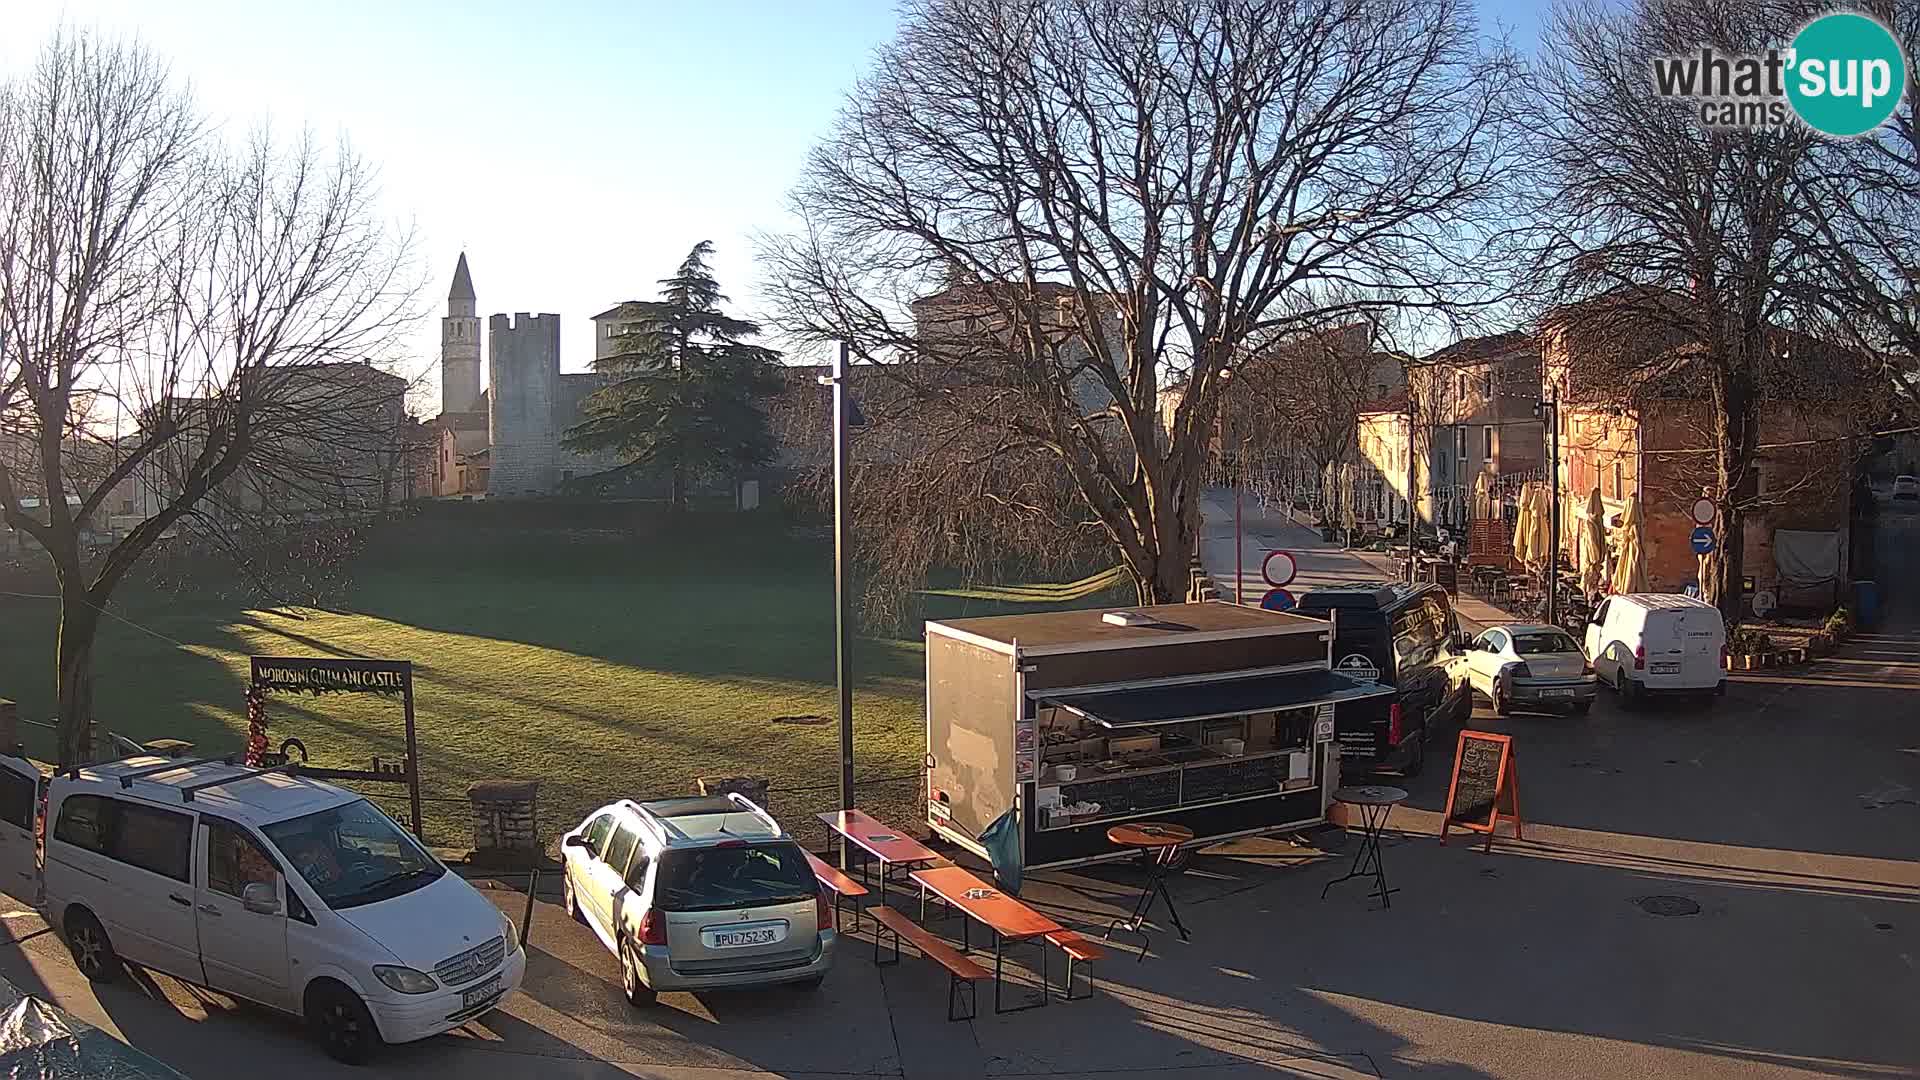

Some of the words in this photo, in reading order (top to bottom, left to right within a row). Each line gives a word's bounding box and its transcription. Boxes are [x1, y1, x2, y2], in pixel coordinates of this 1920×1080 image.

[258, 667, 309, 684] MOROSINI
[310, 668, 362, 686] GRIMANI
[363, 671, 404, 687] CASTLE
